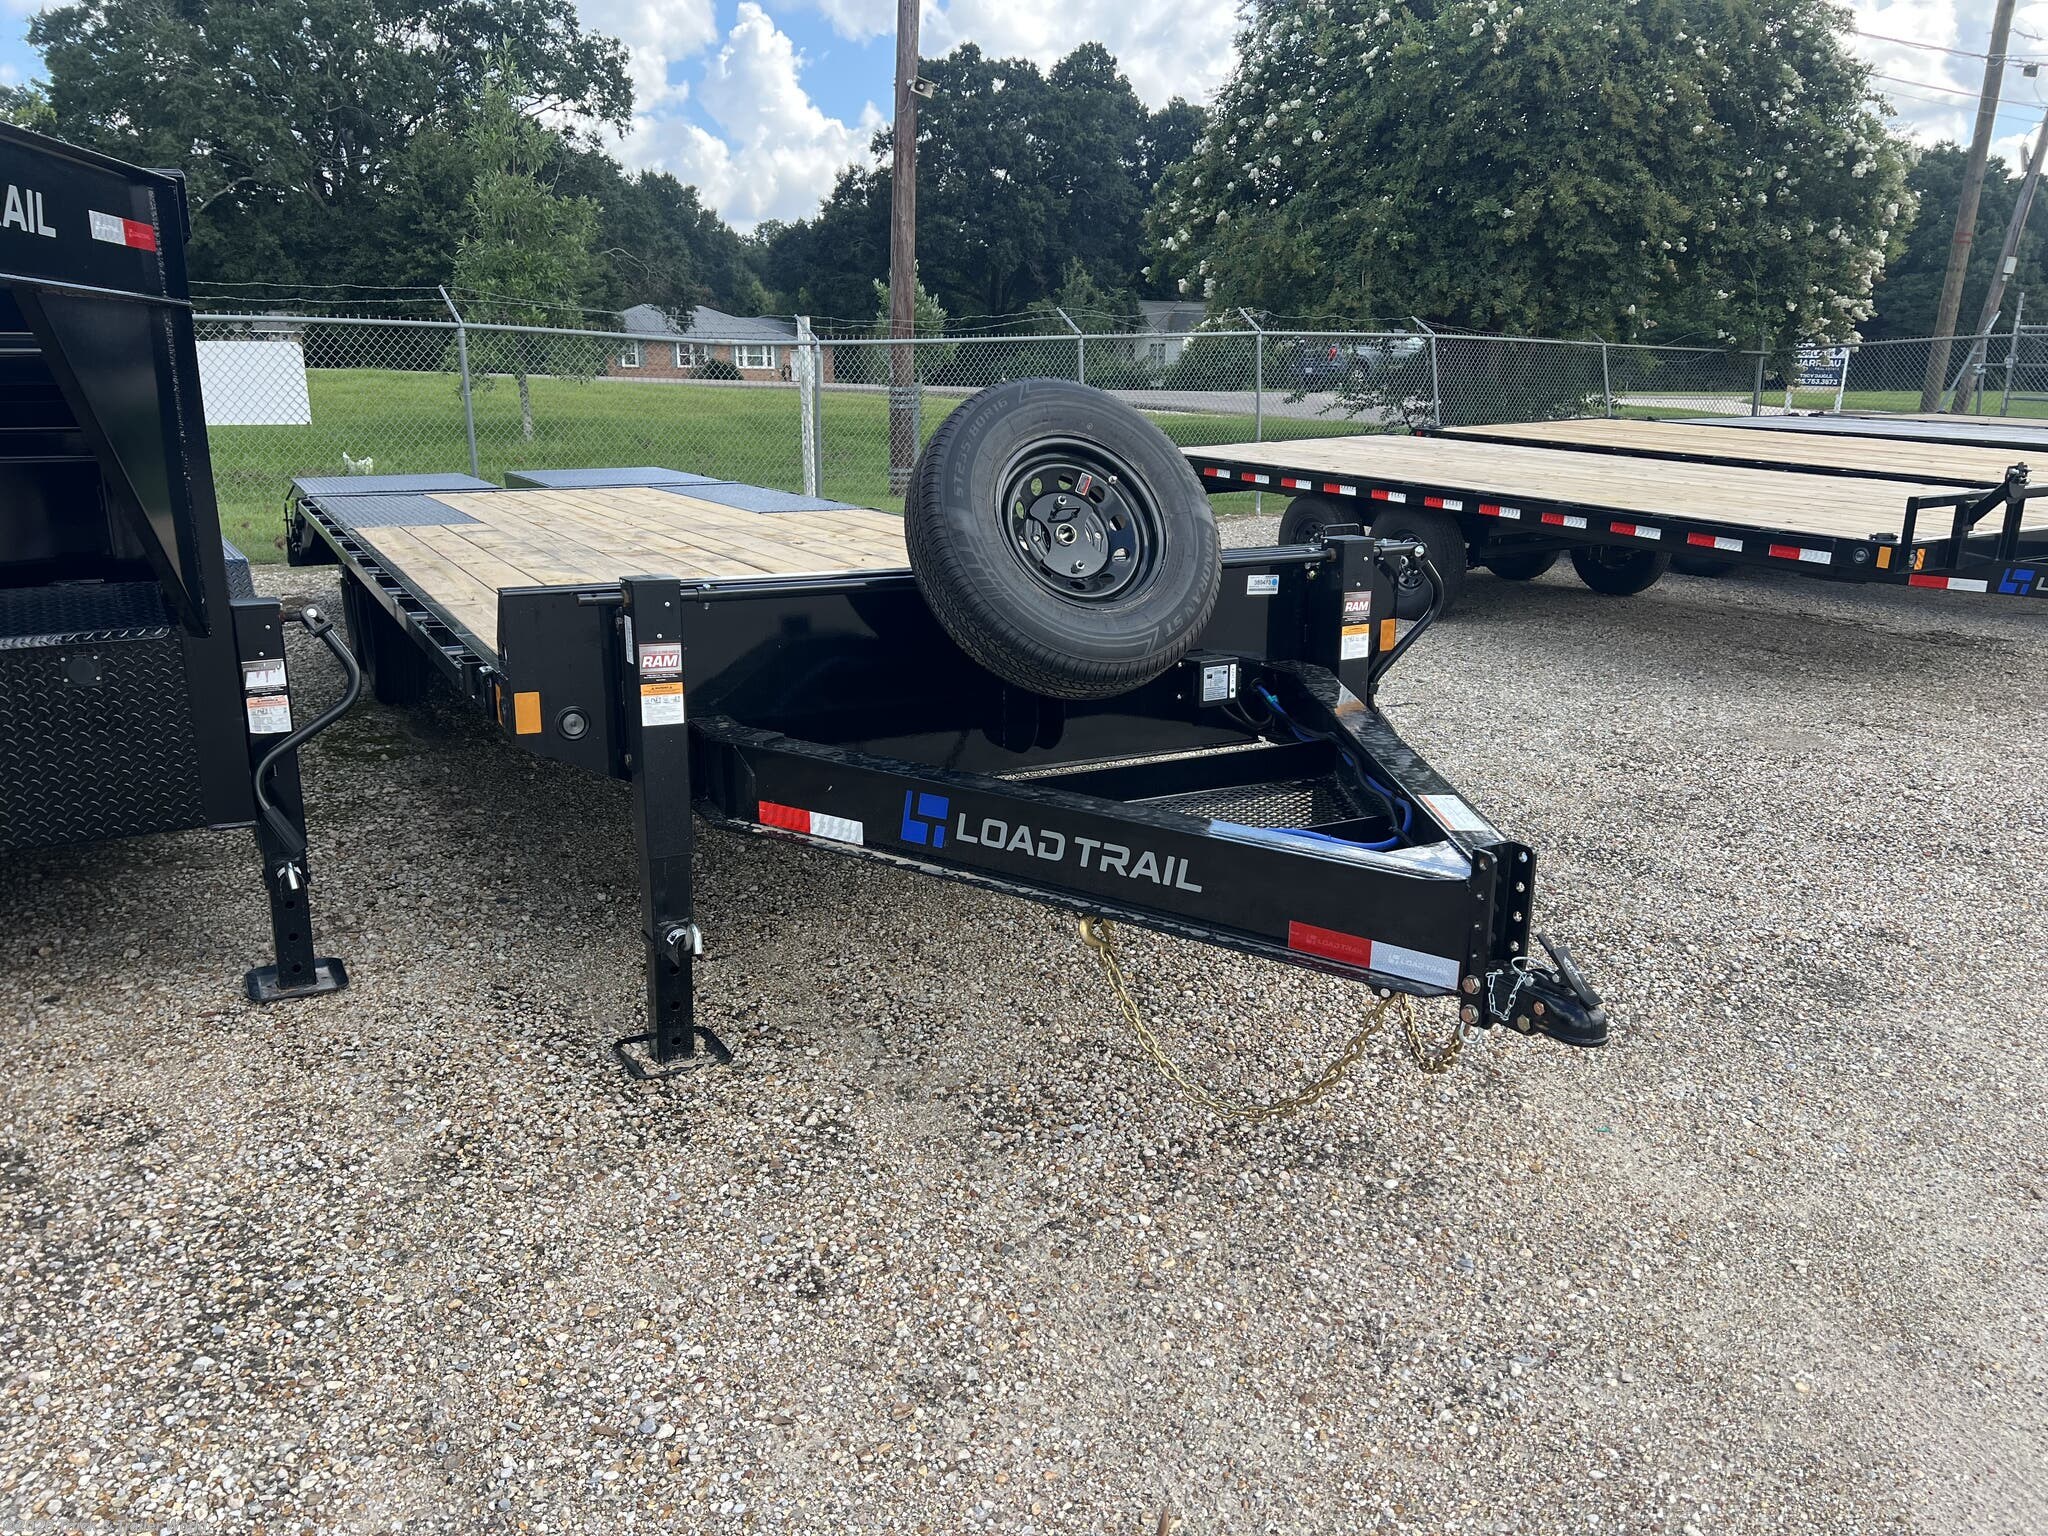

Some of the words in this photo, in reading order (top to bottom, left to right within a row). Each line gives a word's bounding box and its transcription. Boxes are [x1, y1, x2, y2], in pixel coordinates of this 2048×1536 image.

[0, 184, 57, 238] AIL
[1345, 600, 1369, 612] RAM
[642, 654, 679, 668] RAM
[955, 812, 1066, 862] LOAD
[1074, 836, 1203, 893] TRAIL
[1317, 938, 1342, 950] LOAD
[1399, 958, 1424, 969] LOAD
